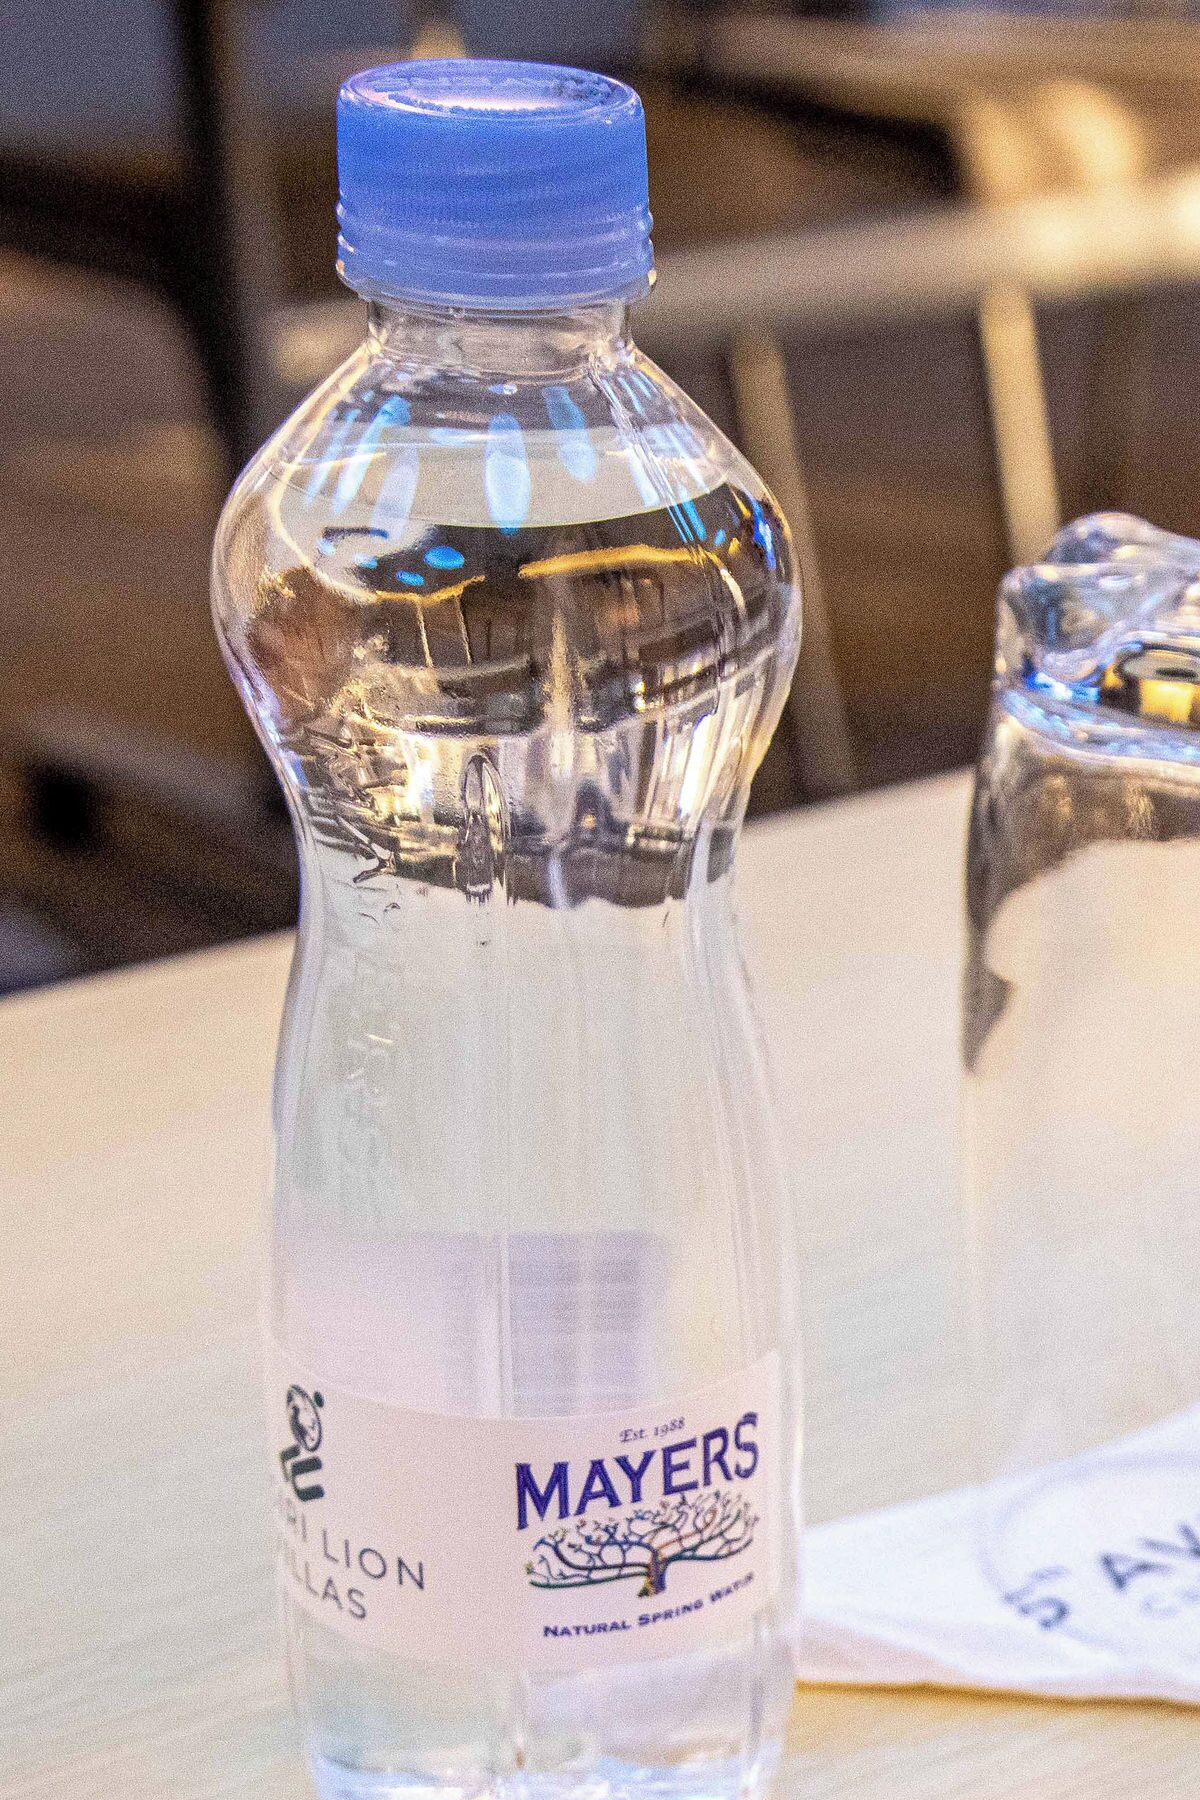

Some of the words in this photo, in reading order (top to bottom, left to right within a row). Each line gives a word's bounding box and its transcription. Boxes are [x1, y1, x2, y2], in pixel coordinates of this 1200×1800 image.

[653, 1416, 686, 1436] 1988
[515, 1411, 760, 1530] MAYERS
[321, 1528, 425, 1591] LION
